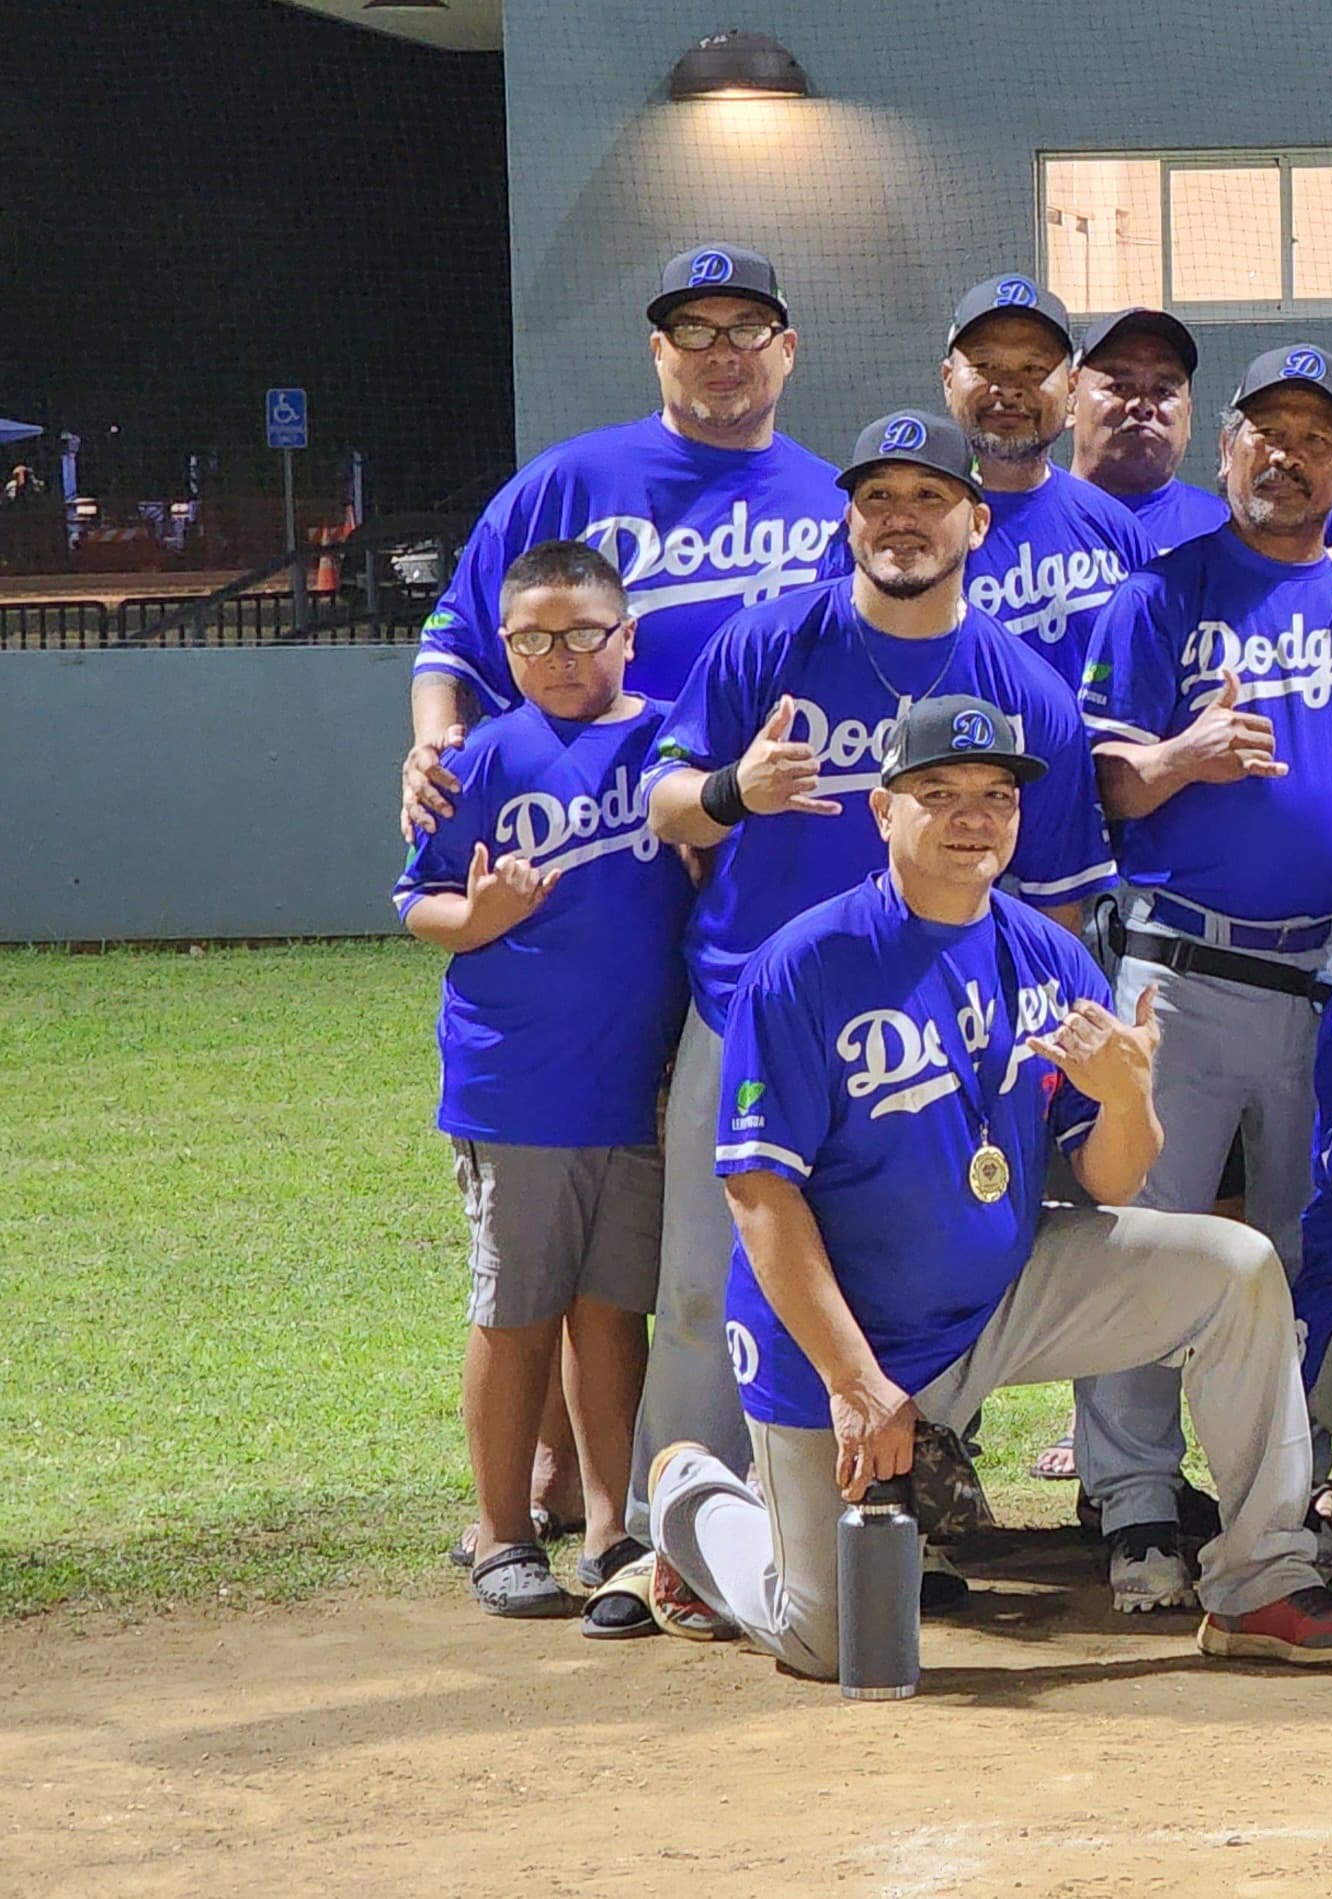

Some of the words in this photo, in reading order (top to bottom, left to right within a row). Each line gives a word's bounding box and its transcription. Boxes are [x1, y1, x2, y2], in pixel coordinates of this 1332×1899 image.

[689, 249, 734, 288] D
[994, 273, 1038, 311] D
[1280, 348, 1327, 383] D
[880, 415, 927, 454] D
[951, 709, 995, 751] D
